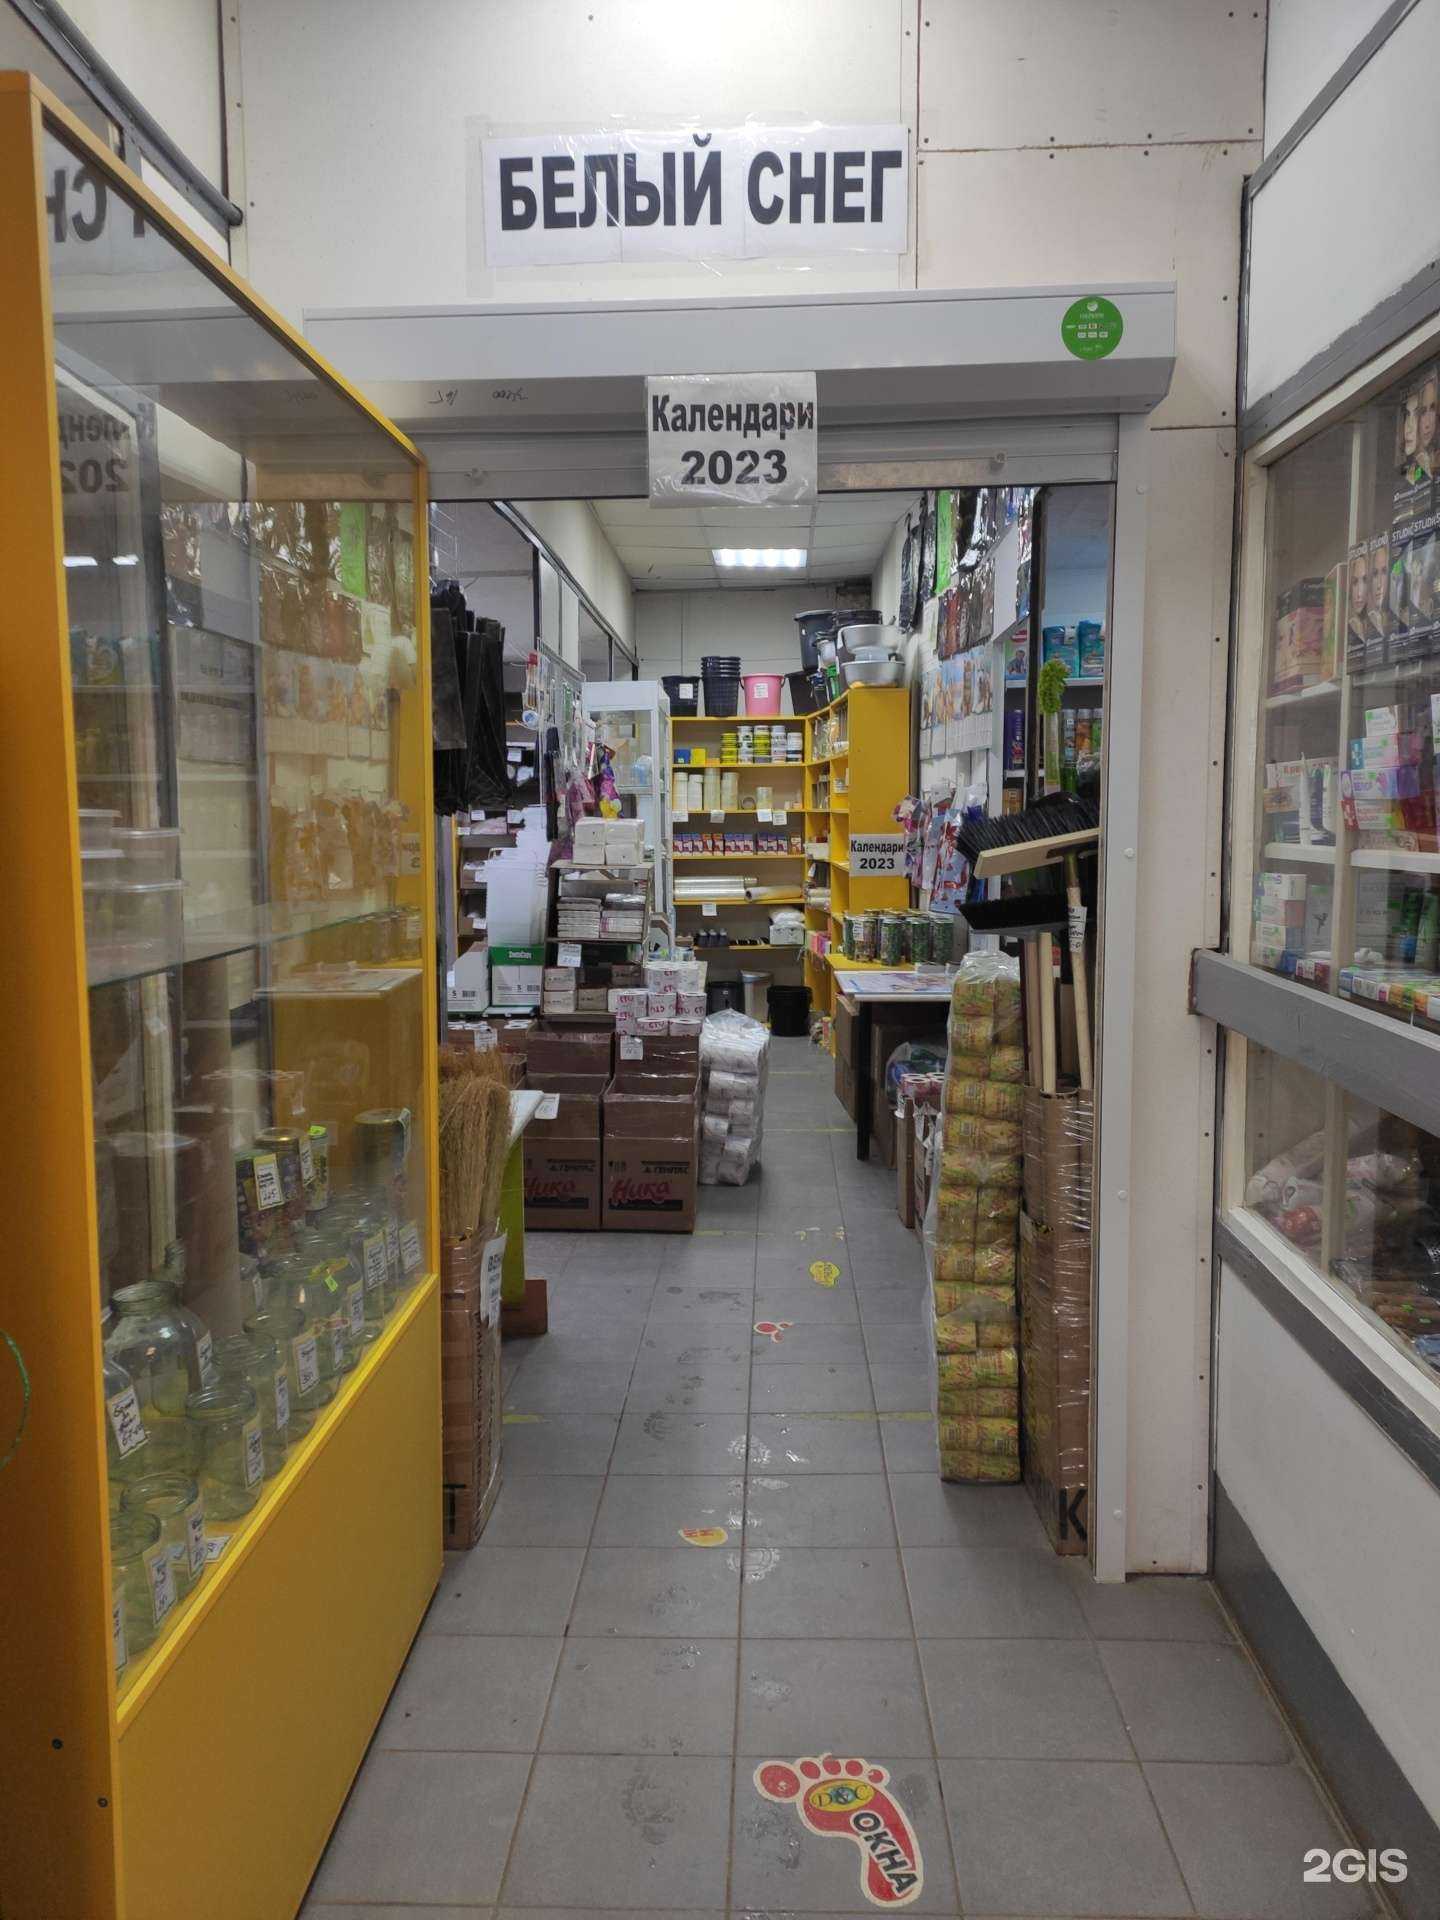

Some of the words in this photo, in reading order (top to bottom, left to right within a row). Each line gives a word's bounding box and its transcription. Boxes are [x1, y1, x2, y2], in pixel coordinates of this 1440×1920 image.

[500, 133, 722, 231] БЕЛЫЙ
[747, 150, 902, 225] СНЕГ
[652, 395, 814, 439] Календари
[680, 449, 787, 485] 2023
[851, 840, 904, 855] Календари
[860, 858, 895, 870] 2023
[853, 1812, 918, 1893] ОКНА
